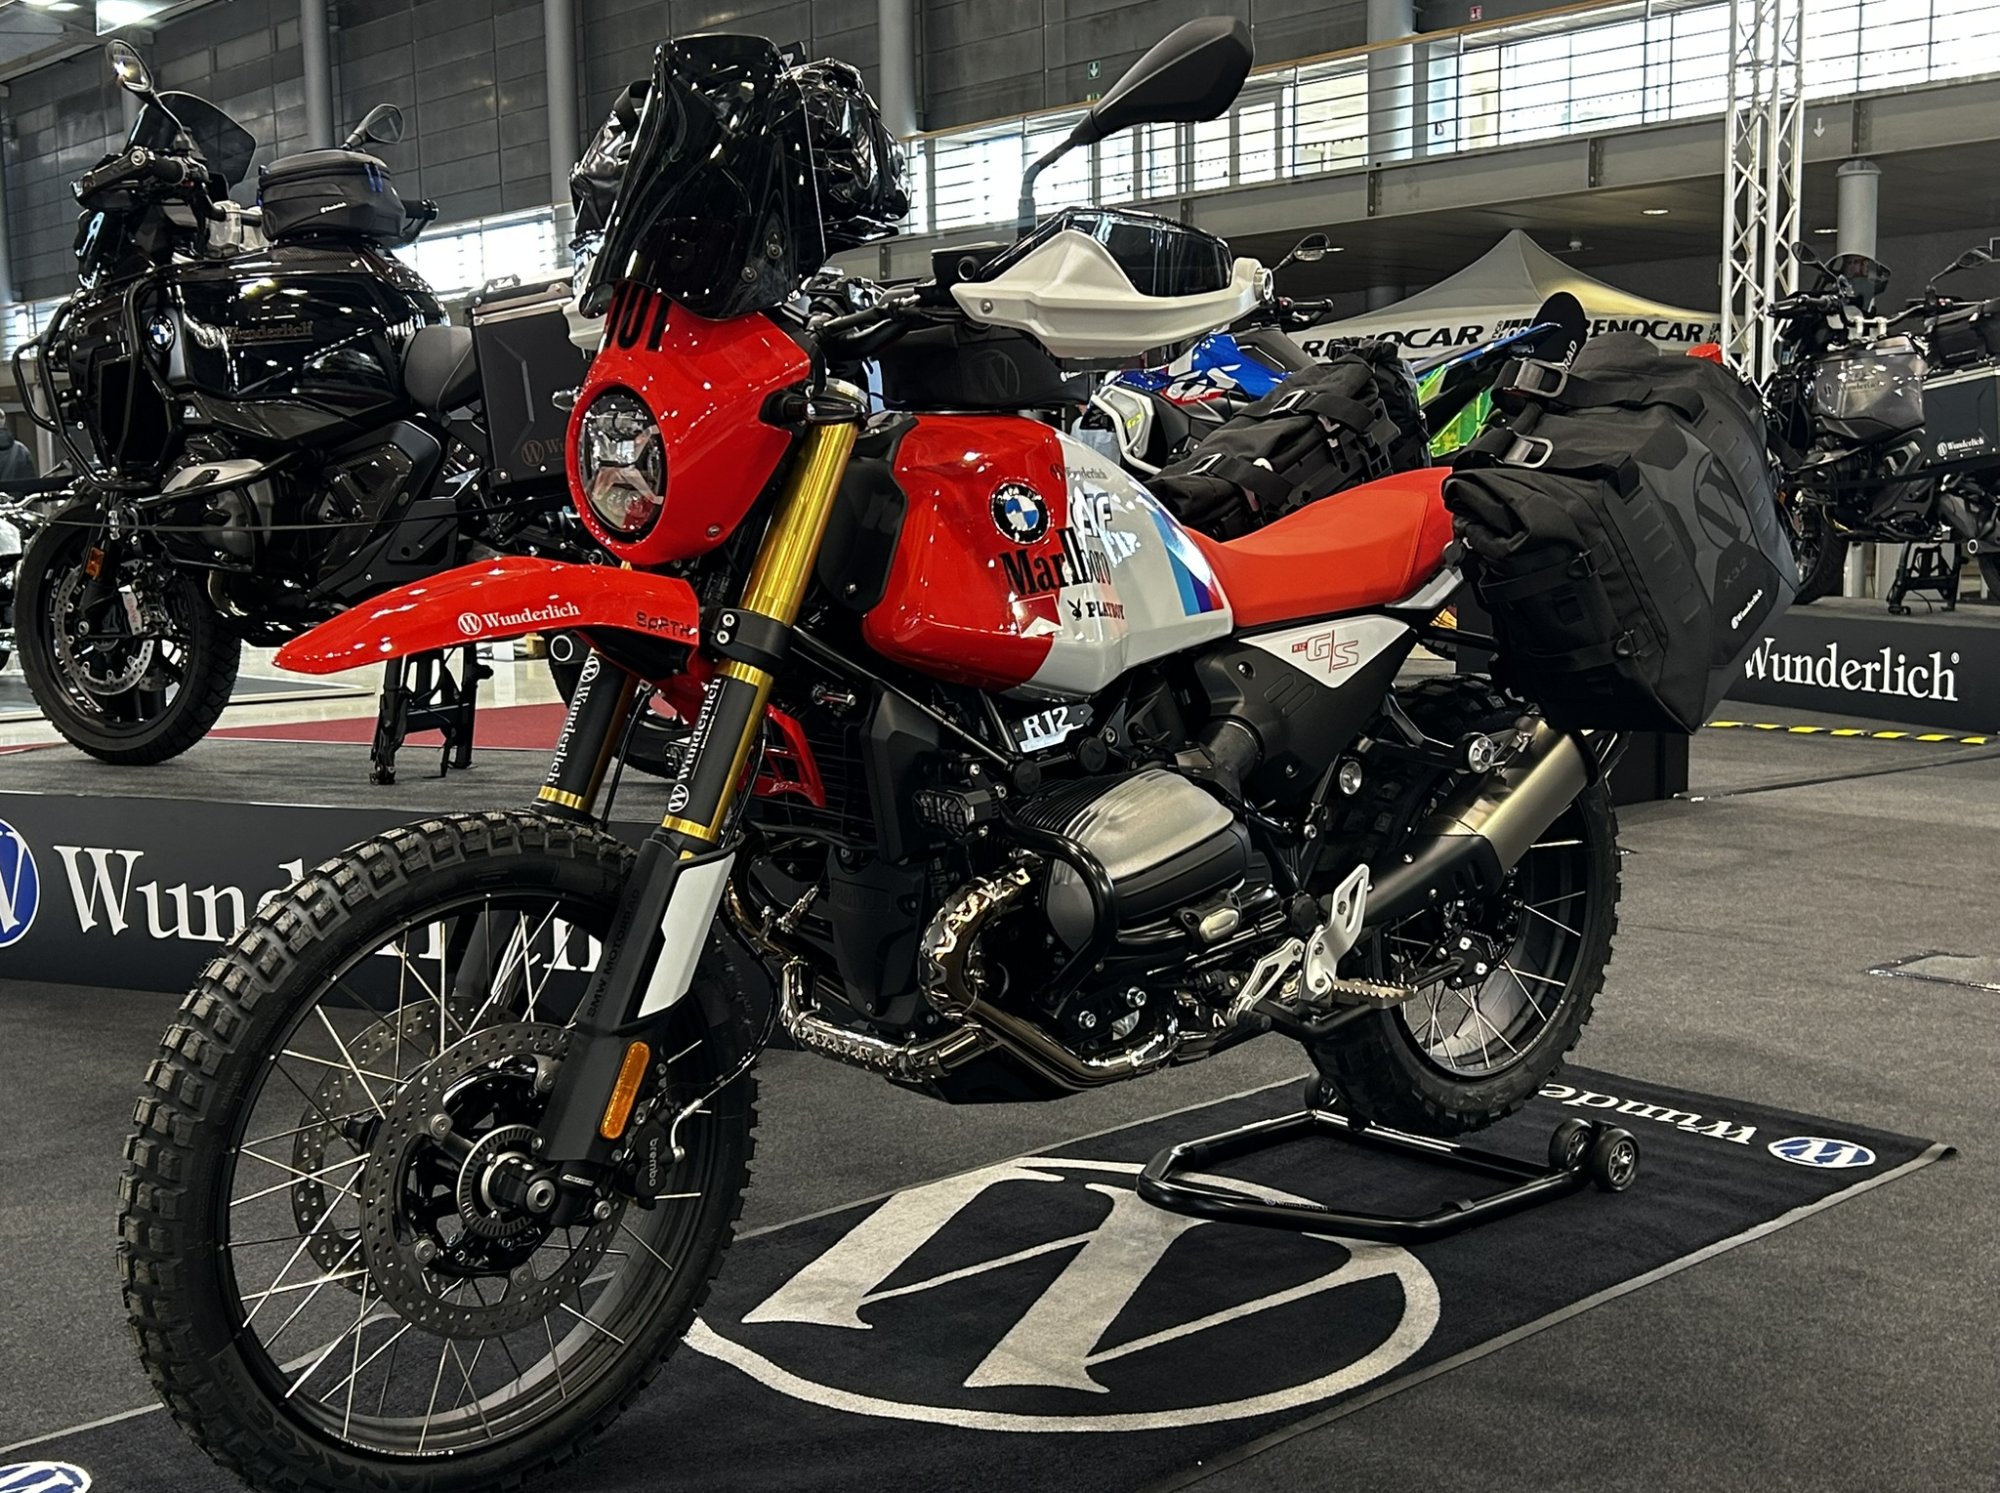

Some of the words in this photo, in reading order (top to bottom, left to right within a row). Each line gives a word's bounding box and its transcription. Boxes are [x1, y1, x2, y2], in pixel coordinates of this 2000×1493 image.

[1302, 324, 1484, 359] ROCAR
[1584, 318, 1704, 343] ENOCAR
[998, 526, 1112, 597] Marlboro
[481, 601, 582, 629] Wunderlich
[1085, 601, 1126, 620] PLAYBOY
[546, 684, 592, 784] Wunderlich
[677, 677, 722, 782] Wunderlich
[1022, 705, 1074, 741] R12
[1538, 1083, 1758, 1145] Wunde
[648, 1137, 660, 1188] brembo
